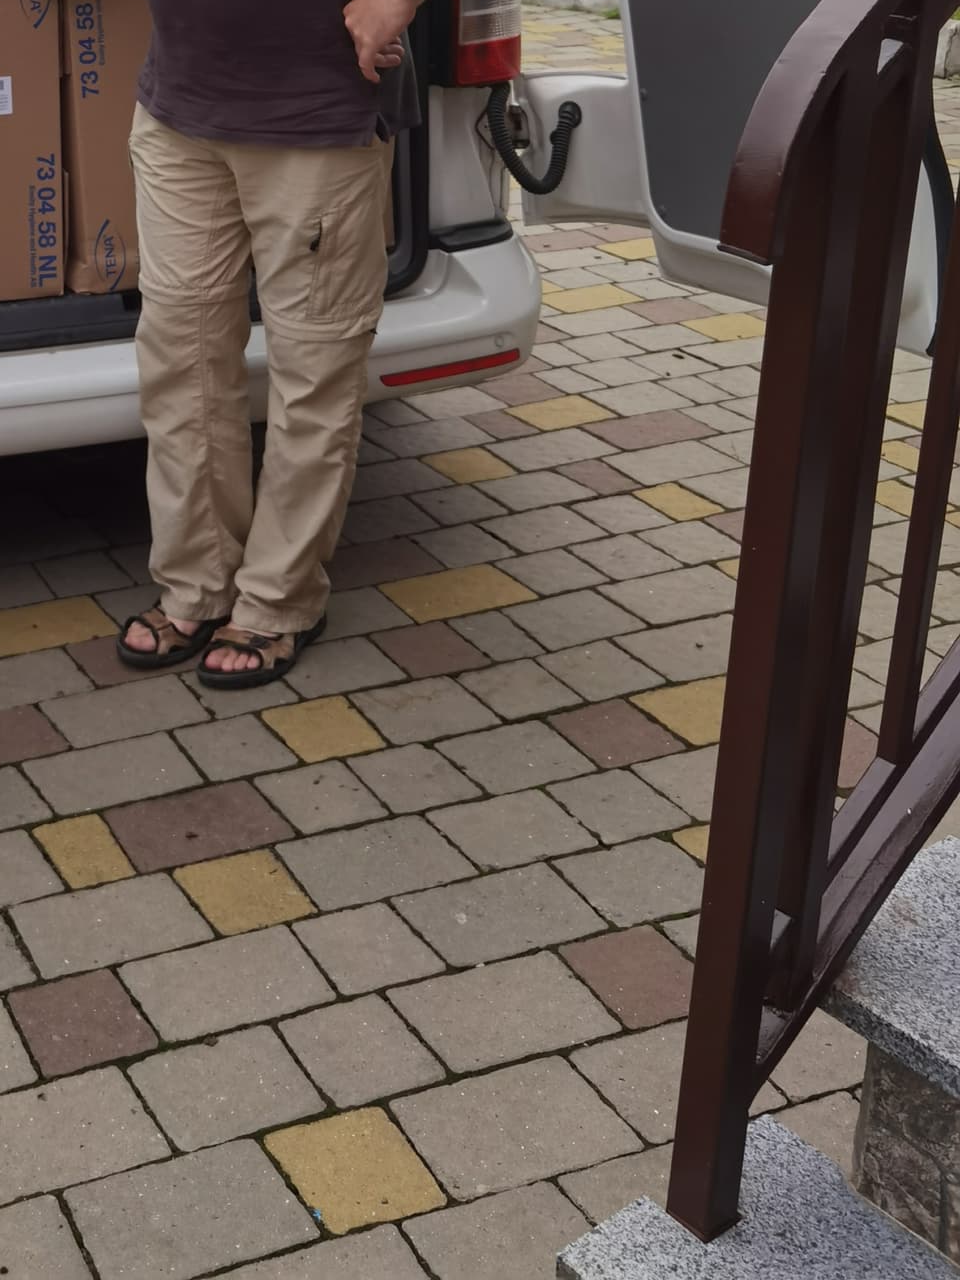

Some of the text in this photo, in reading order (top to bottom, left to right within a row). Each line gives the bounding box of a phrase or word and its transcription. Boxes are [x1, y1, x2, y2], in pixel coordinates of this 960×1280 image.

[75, 3, 94, 30] 58
[78, 37, 97, 64] 04
[80, 70, 99, 98] 73
[37, 153, 58, 287] 73 04 58 NL
[103, 236, 117, 278] TENA
